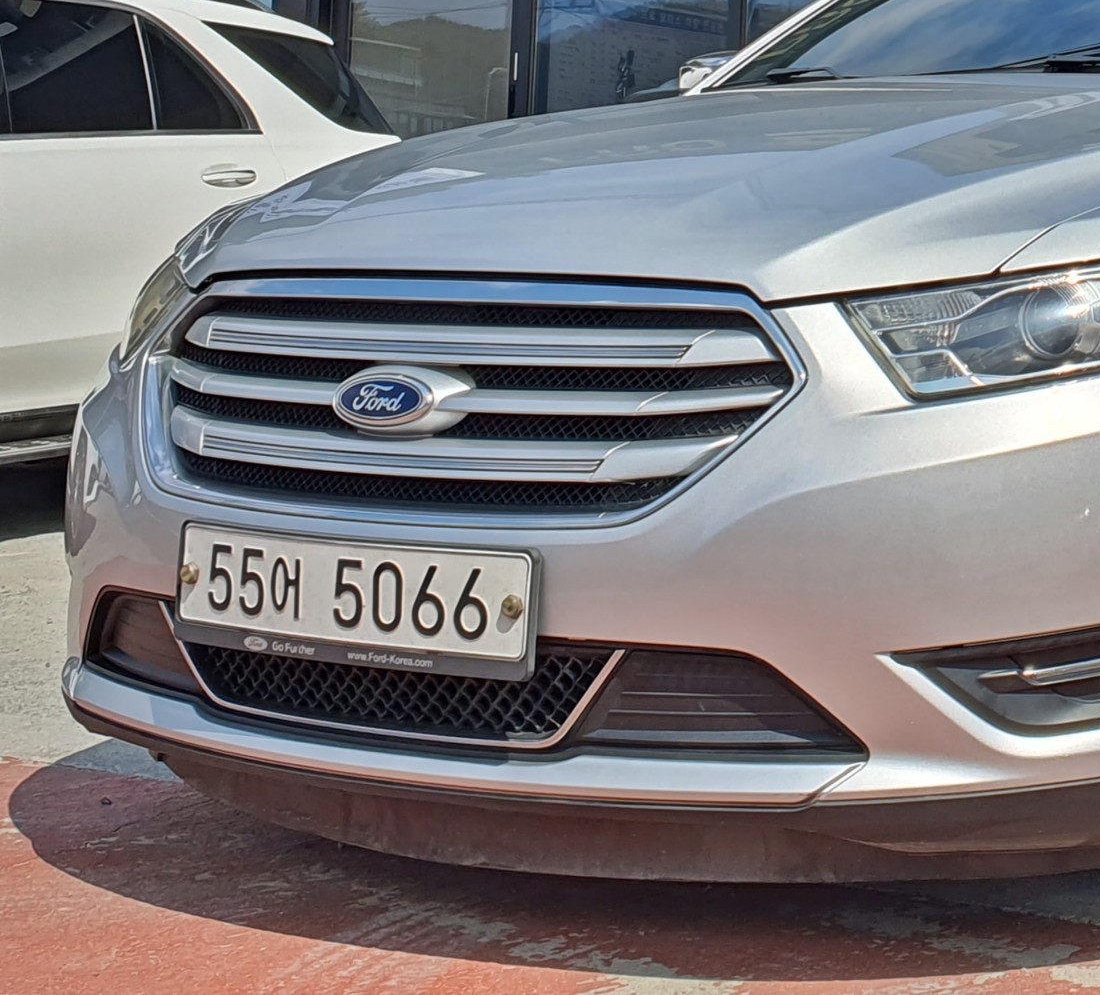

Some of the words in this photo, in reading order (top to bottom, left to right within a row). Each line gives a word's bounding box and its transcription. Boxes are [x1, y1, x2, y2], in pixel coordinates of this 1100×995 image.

[352, 383, 406, 412] Ford
[207, 543, 301, 621] 55어
[333, 559, 488, 640] 5066
[271, 640, 284, 652] Go
[346, 651, 434, 669] www.Ford-Korea.com
